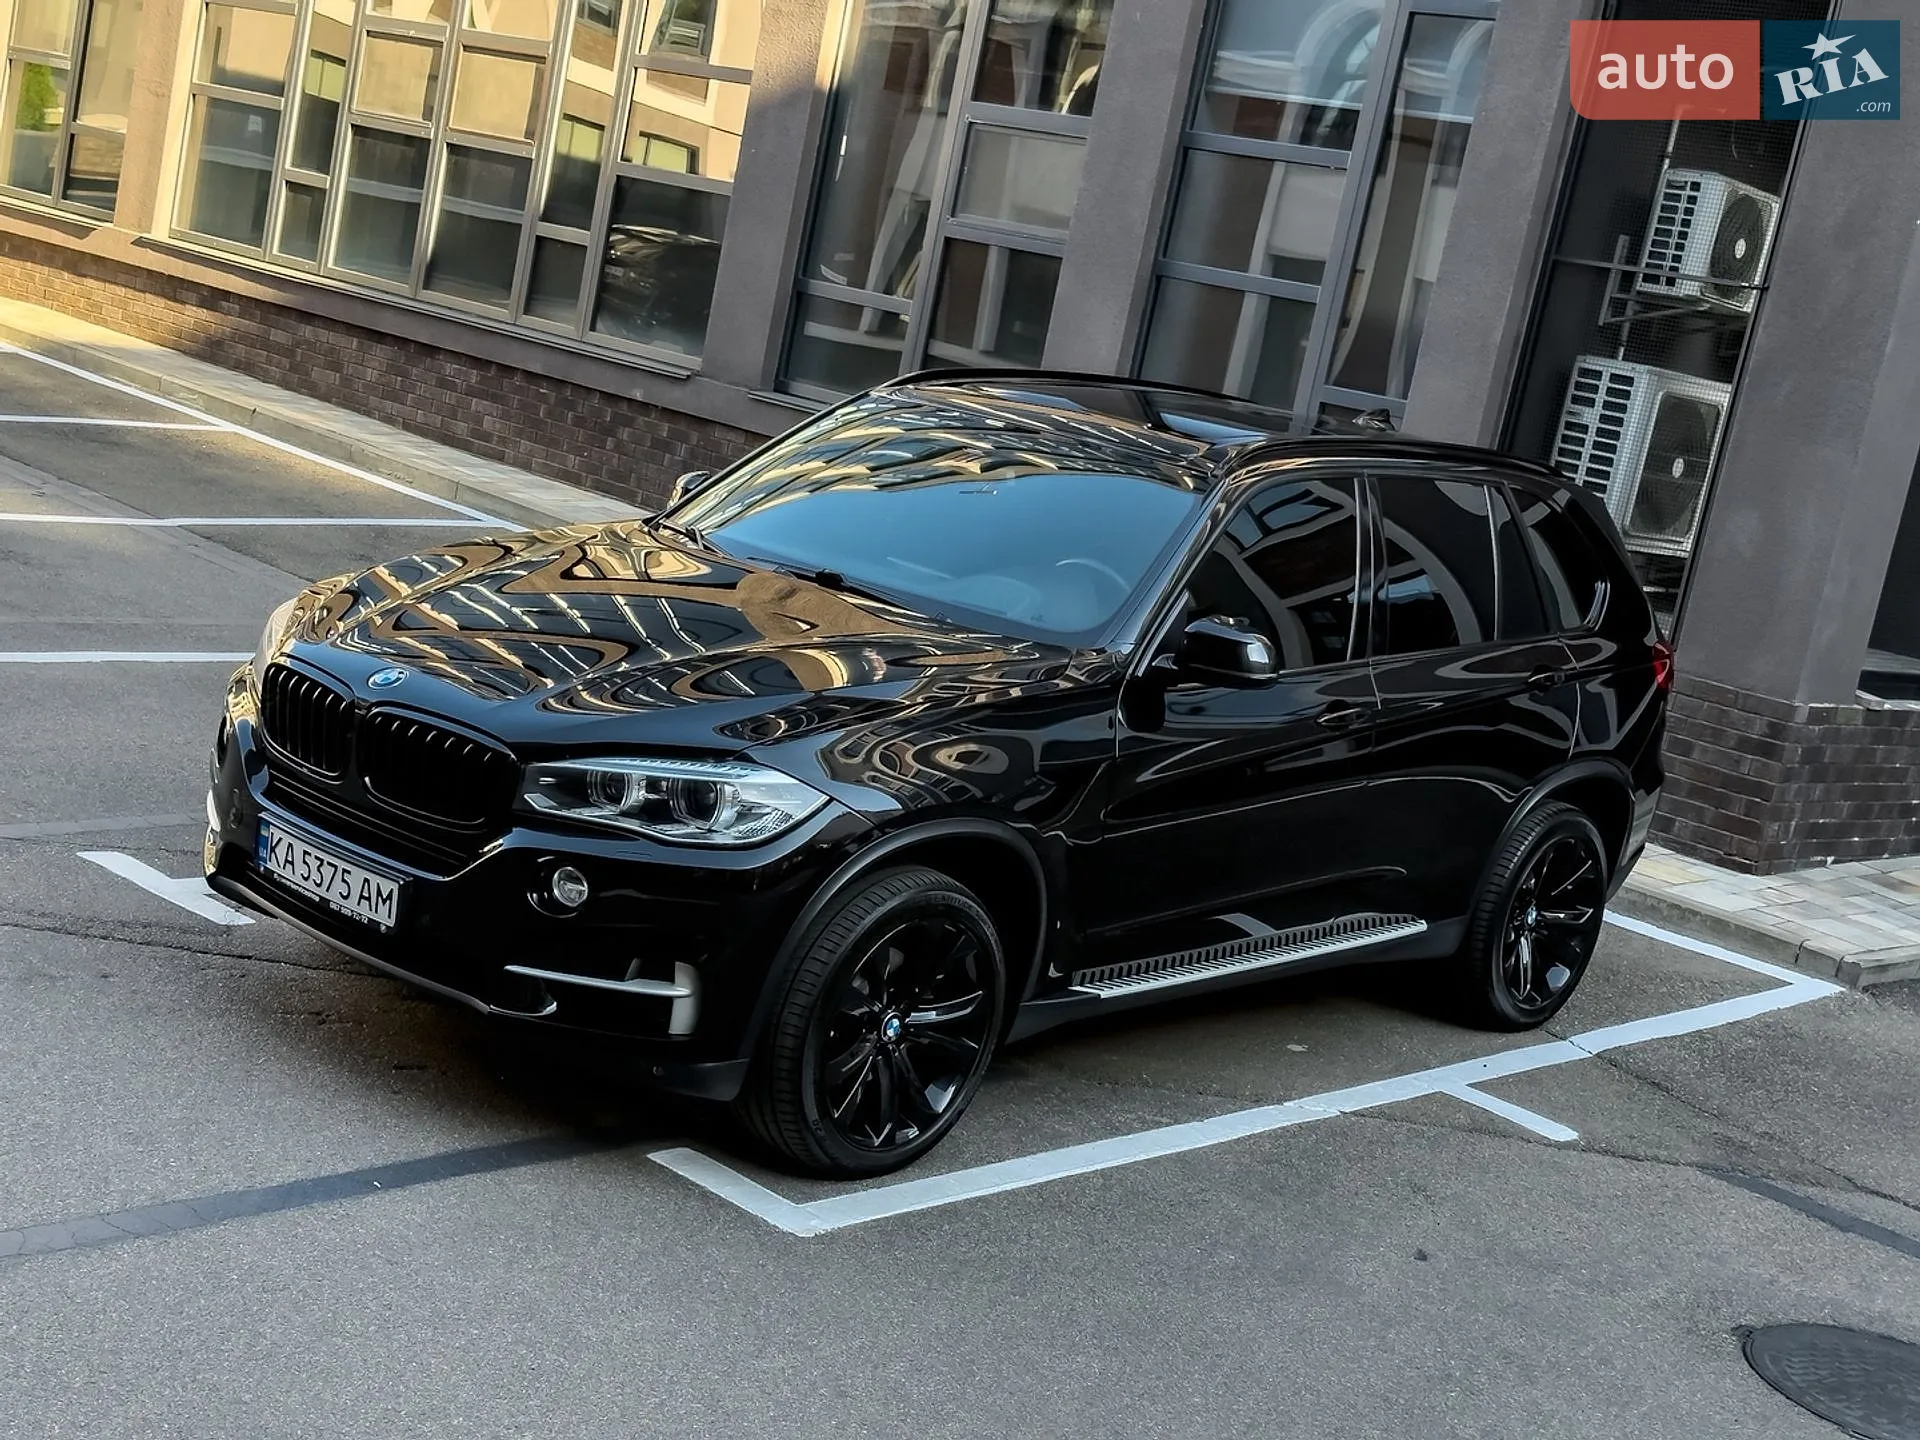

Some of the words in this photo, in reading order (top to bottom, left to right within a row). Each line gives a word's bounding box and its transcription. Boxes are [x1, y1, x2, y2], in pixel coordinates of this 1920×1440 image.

[268, 831, 295, 875] KA
[300, 850, 352, 901] 5375
[357, 877, 394, 920] AM
